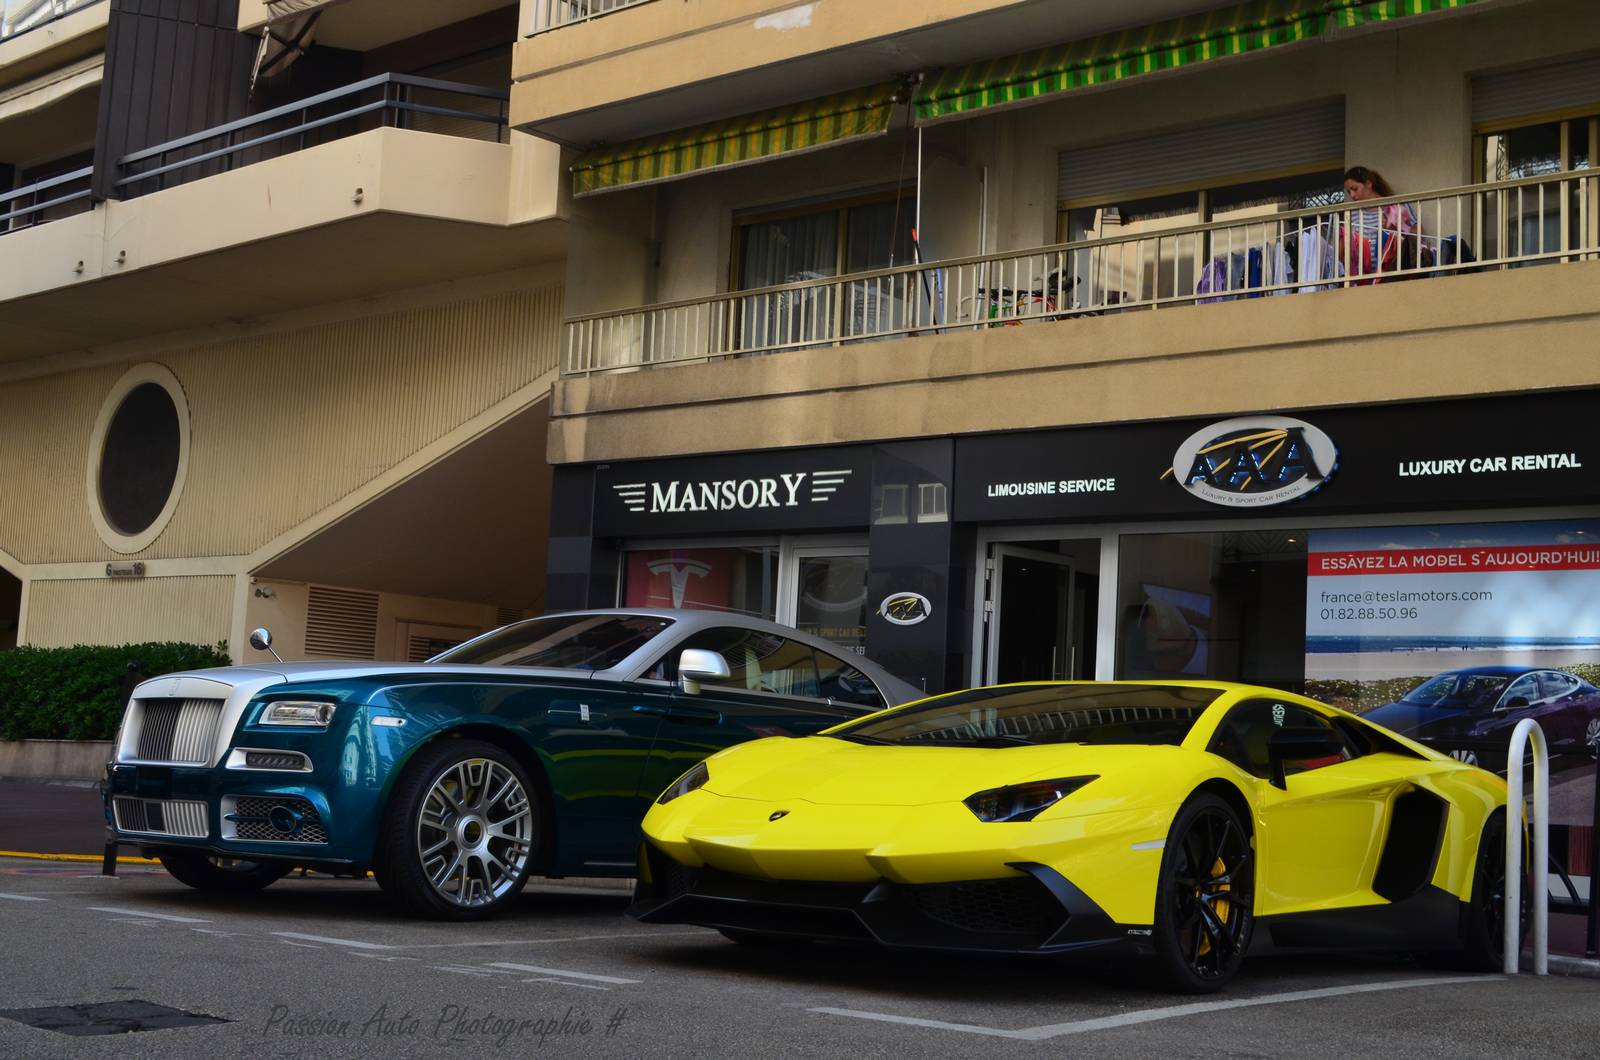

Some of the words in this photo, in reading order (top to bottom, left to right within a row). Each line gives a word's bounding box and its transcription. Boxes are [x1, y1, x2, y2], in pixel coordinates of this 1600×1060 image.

[1399, 458, 1467, 476] LUXURY
[1469, 456, 1508, 473] CAR
[1511, 453, 1582, 471] RENTAL
[650, 472, 807, 513] MANSORY
[988, 481, 1056, 497] LIMOUSINE
[1058, 478, 1116, 494] SERVICE
[1235, 496, 1257, 504] SPORT
[1275, 486, 1301, 500] RENTAL
[133, 562, 143, 576] 16
[1321, 556, 1385, 570] ESSAYEZ
[1388, 556, 1408, 568] LA
[1412, 554, 1467, 568] MODEL
[1471, 553, 1480, 565] S
[1485, 550, 1600, 566] AUJOURD'HUI!
[1321, 590, 1493, 604] france@teslamotors.com
[1320, 607, 1418, 620] 01.82.88.50.96
